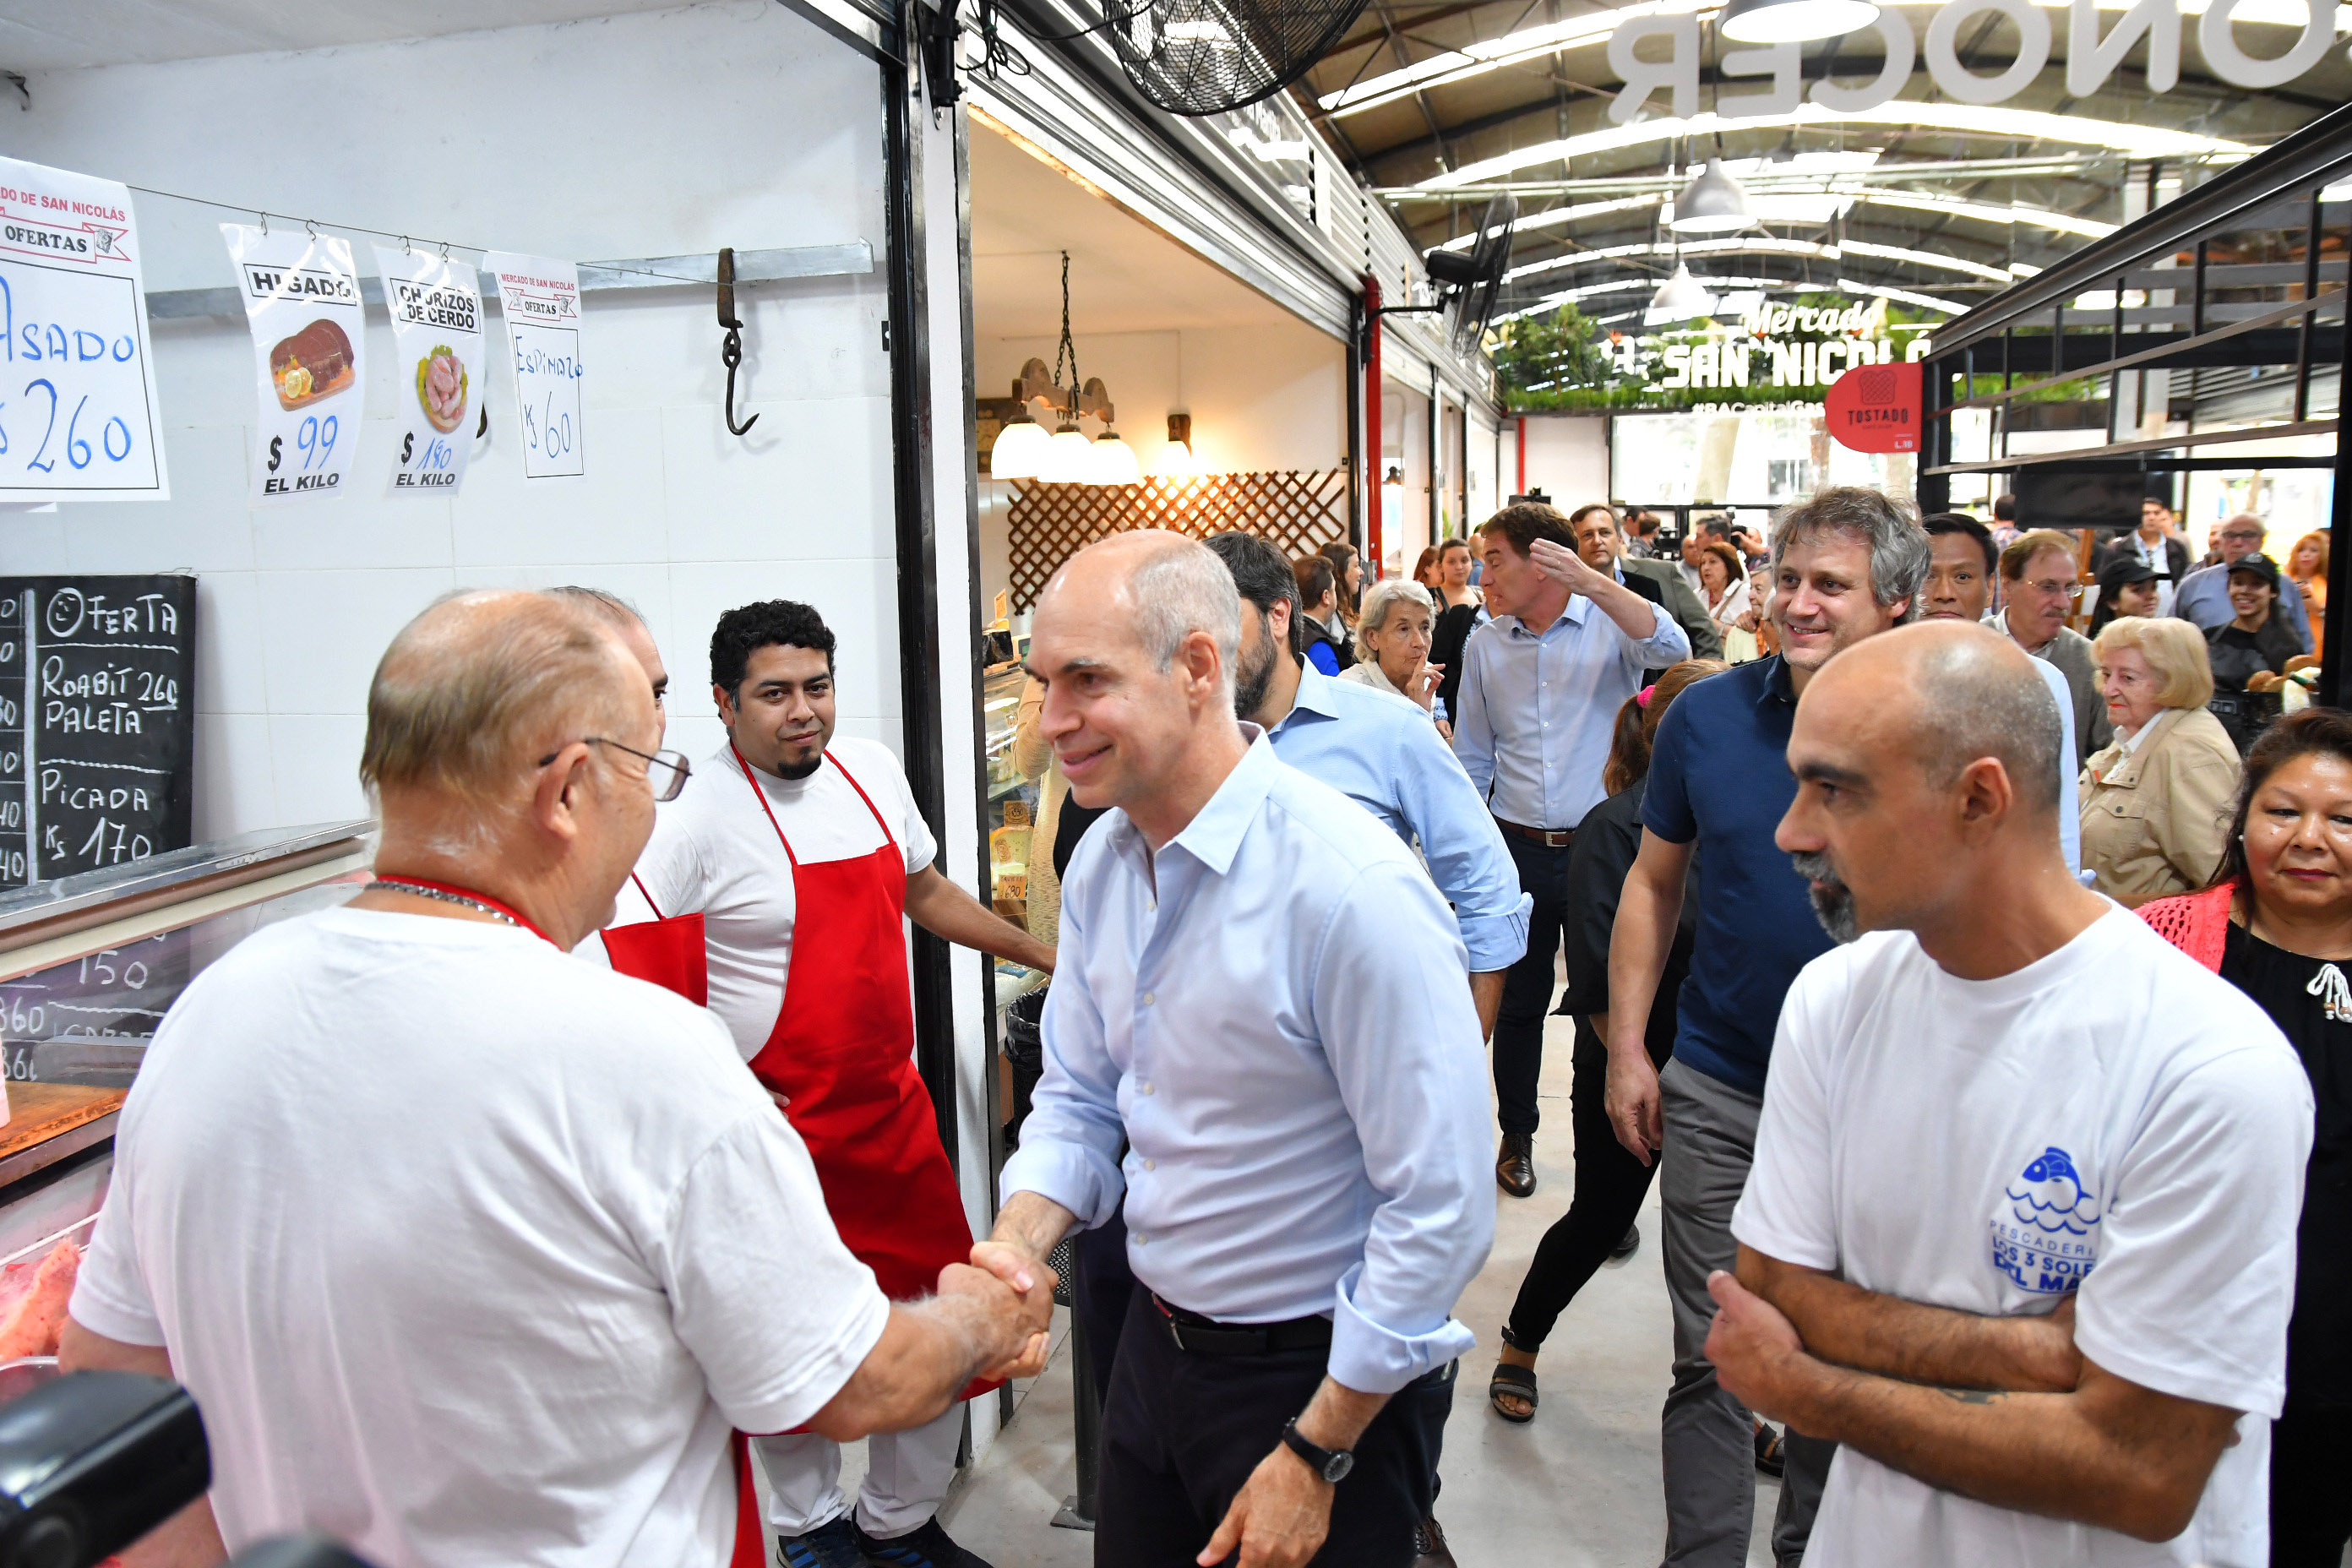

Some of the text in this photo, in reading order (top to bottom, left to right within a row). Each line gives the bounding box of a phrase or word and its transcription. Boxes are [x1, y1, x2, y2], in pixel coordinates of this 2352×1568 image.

[0, 187, 126, 221] DO DE SAN NICOLÁS
[5, 225, 87, 253] OFERTAS
[501, 274, 529, 285] MERCADO
[530, 277, 536, 286] DE
[536, 280, 548, 288] SAN
[407, 304, 475, 329] DE CERDO
[525, 301, 557, 315] OFERTAS
[1663, 330, 1931, 388] SAN NICOL
[1691, 400, 1826, 416] #BACapitalGas
[1848, 408, 1908, 426] TOSTADO
[24, 378, 132, 473] 260
[546, 391, 570, 459] 60
[268, 416, 338, 475] $ 99
[401, 431, 414, 467] $
[264, 472, 340, 493] EL KILO
[396, 473, 455, 486] EL KILO
[46, 700, 142, 735] PALETA
[78, 817, 151, 865] 170
[79, 950, 148, 989] 150
[1990, 1220, 2093, 1255] PESCADERI
[2025, 1251, 2035, 1266] 3
[2042, 1256, 2093, 1277] SOLE
[2039, 1272, 2080, 1290] MA
